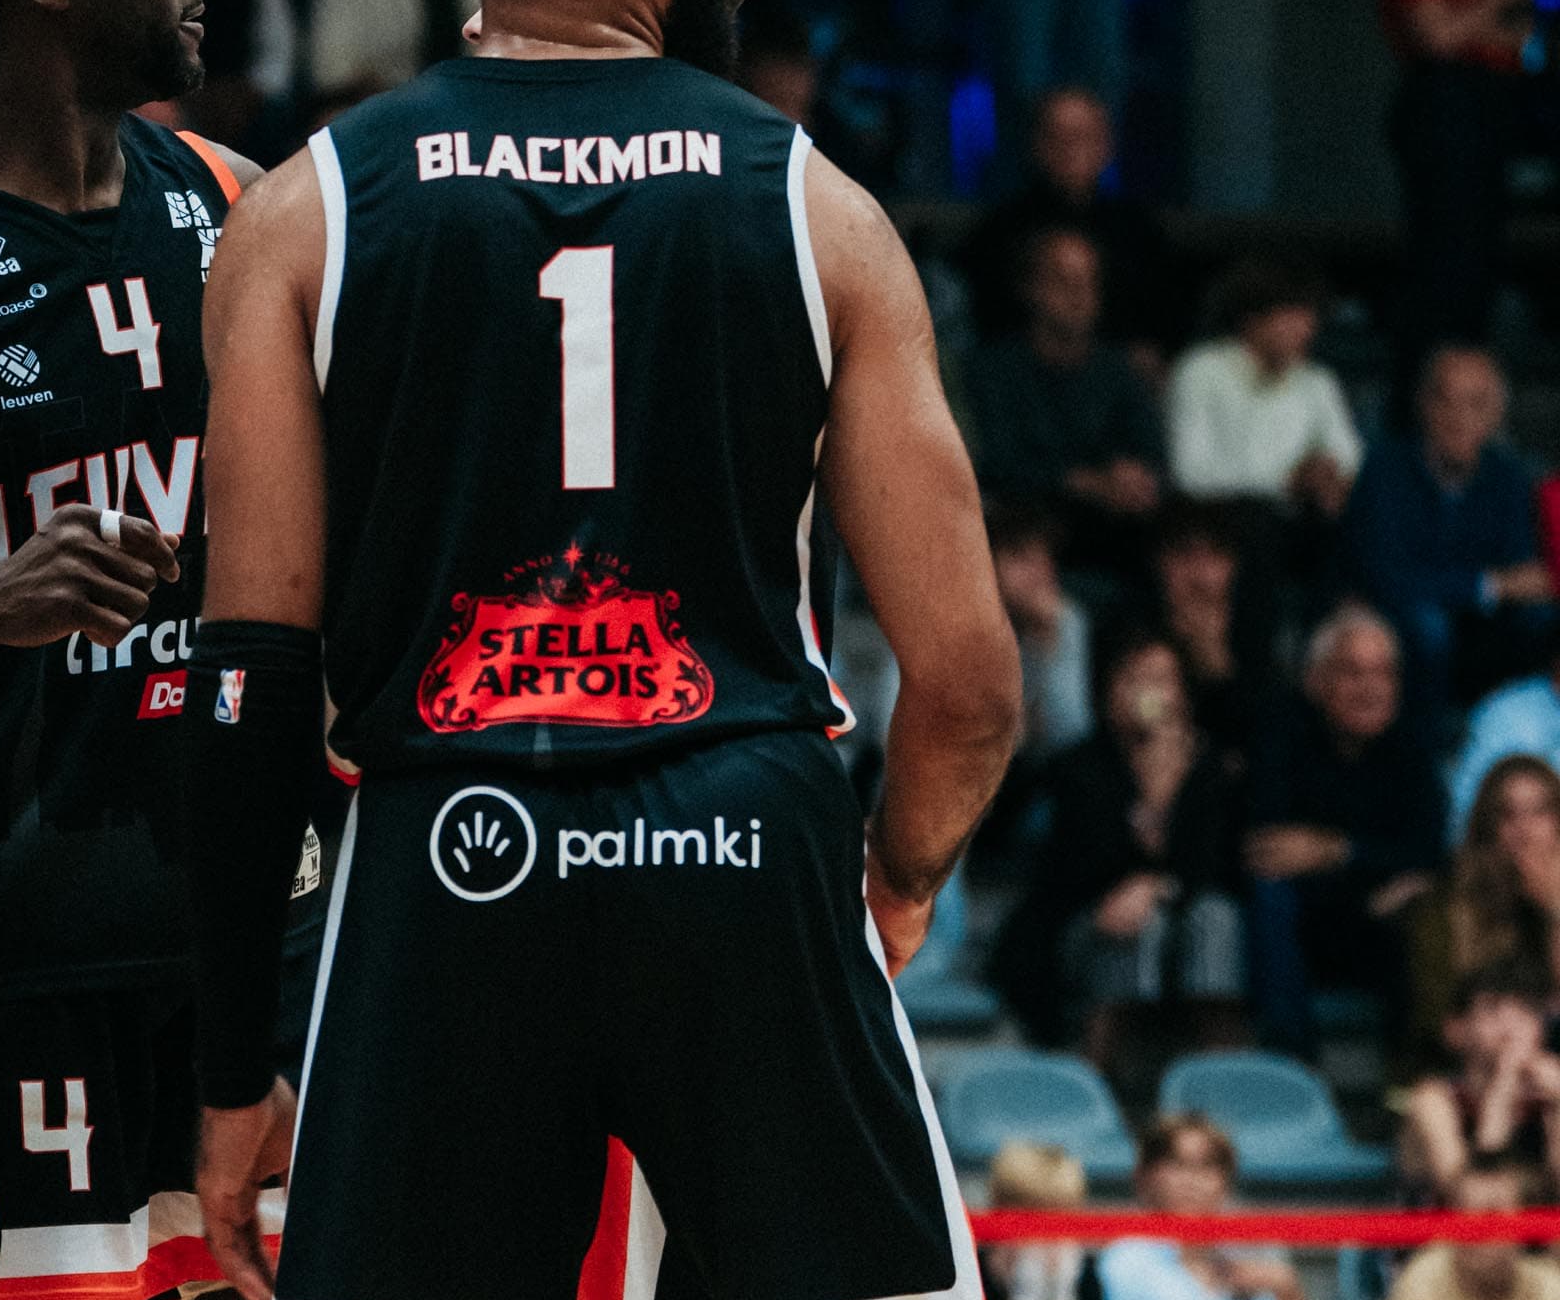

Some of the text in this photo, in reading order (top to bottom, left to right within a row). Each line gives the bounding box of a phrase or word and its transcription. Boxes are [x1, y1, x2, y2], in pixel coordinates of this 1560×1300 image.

[416, 130, 721, 184] BLACKMON
[87, 276, 162, 389] 4
[538, 244, 615, 490] 1
[0, 389, 53, 409] leuven
[479, 622, 652, 660] STELLA
[471, 663, 659, 699] ARTOIS
[558, 814, 762, 879] palmki
[20, 1078, 93, 1192] 4
